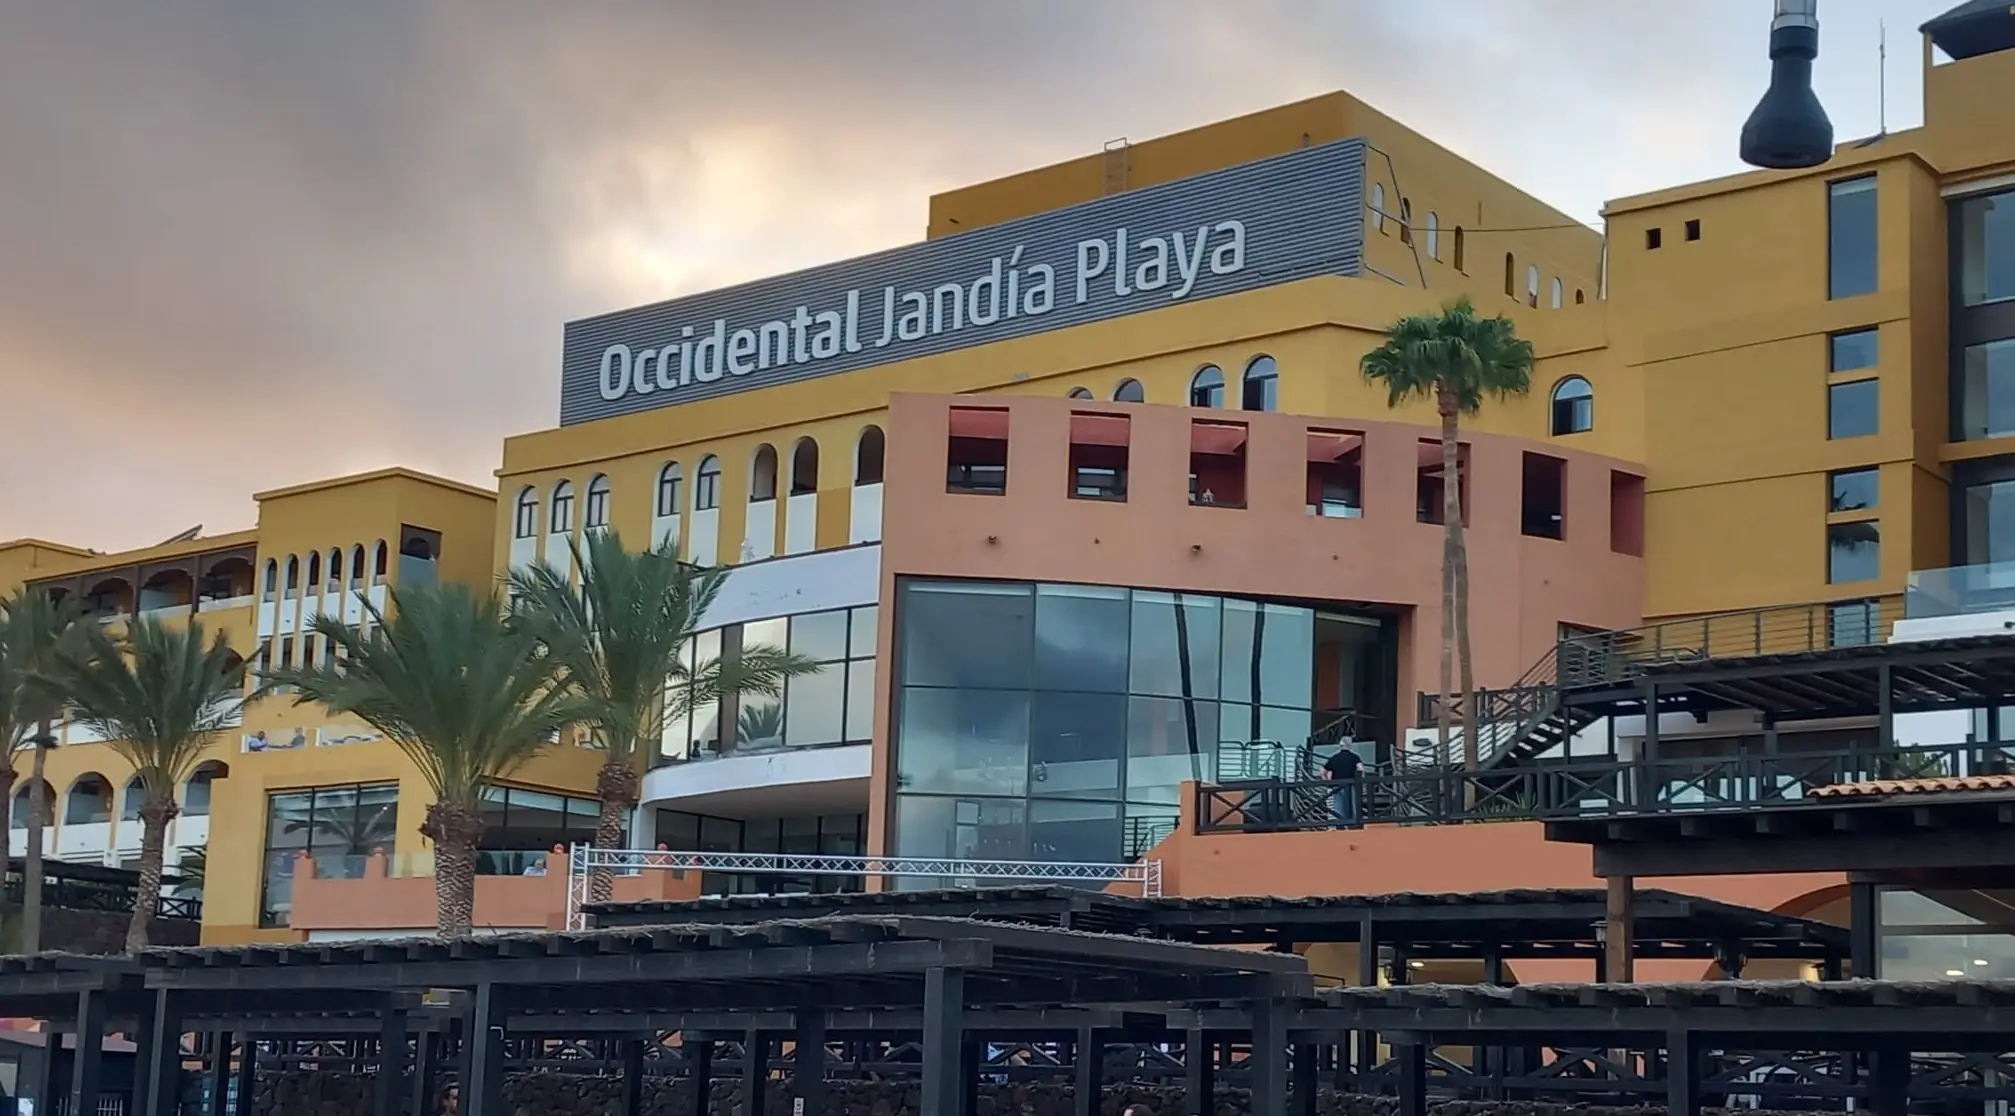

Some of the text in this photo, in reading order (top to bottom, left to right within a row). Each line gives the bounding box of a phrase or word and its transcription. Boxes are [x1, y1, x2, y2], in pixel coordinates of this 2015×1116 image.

[599, 219, 1246, 400] Occidental Jandía Playa
